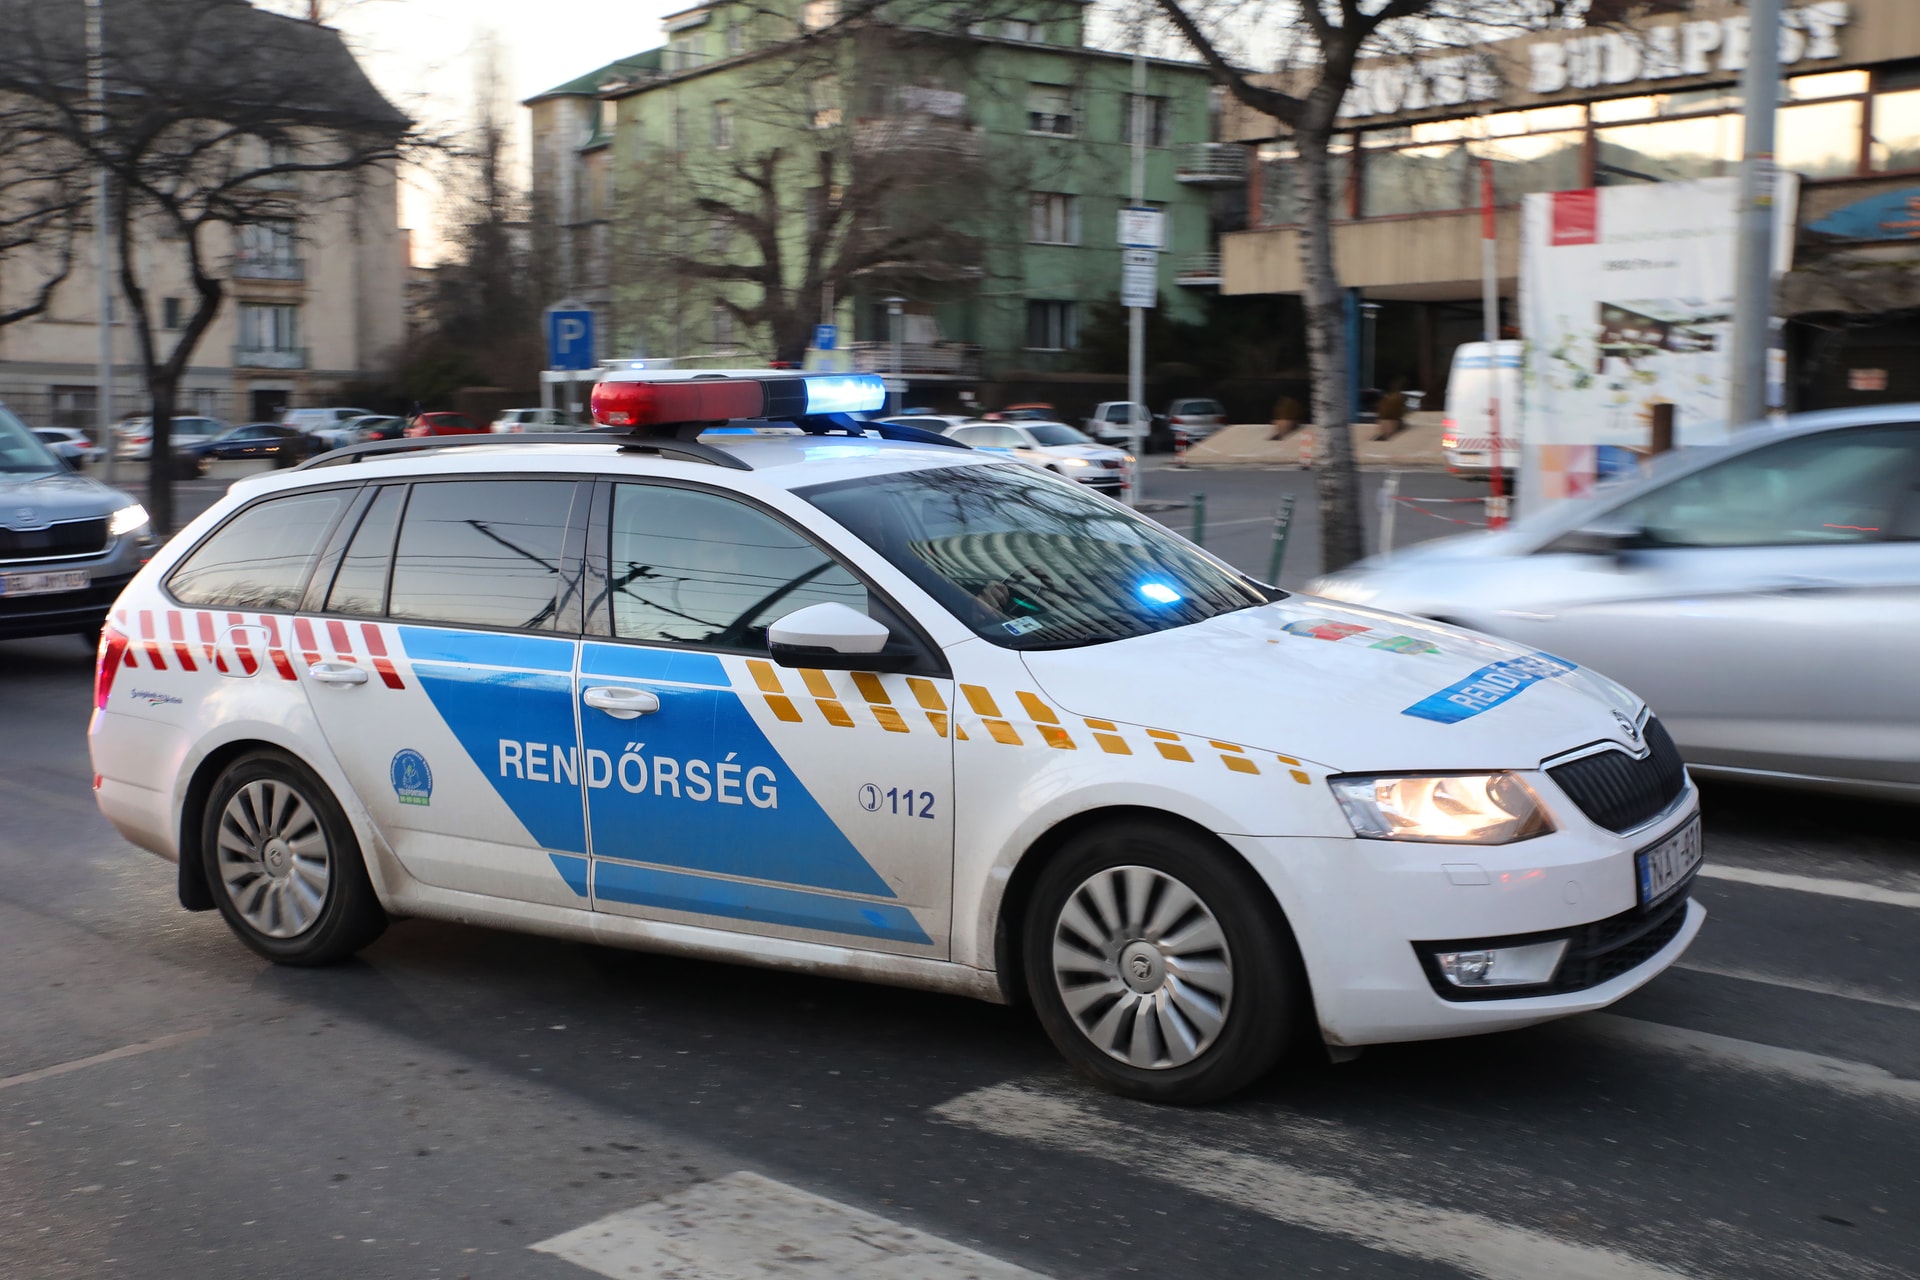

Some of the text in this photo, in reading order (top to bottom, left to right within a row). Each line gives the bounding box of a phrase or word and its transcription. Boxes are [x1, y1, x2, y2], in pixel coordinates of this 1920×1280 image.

[1528, 1, 1849, 93] BUDAPEST
[557, 318, 586, 354] P
[499, 738, 778, 809] RENDŐRSÉG
[886, 787, 936, 820] 112
